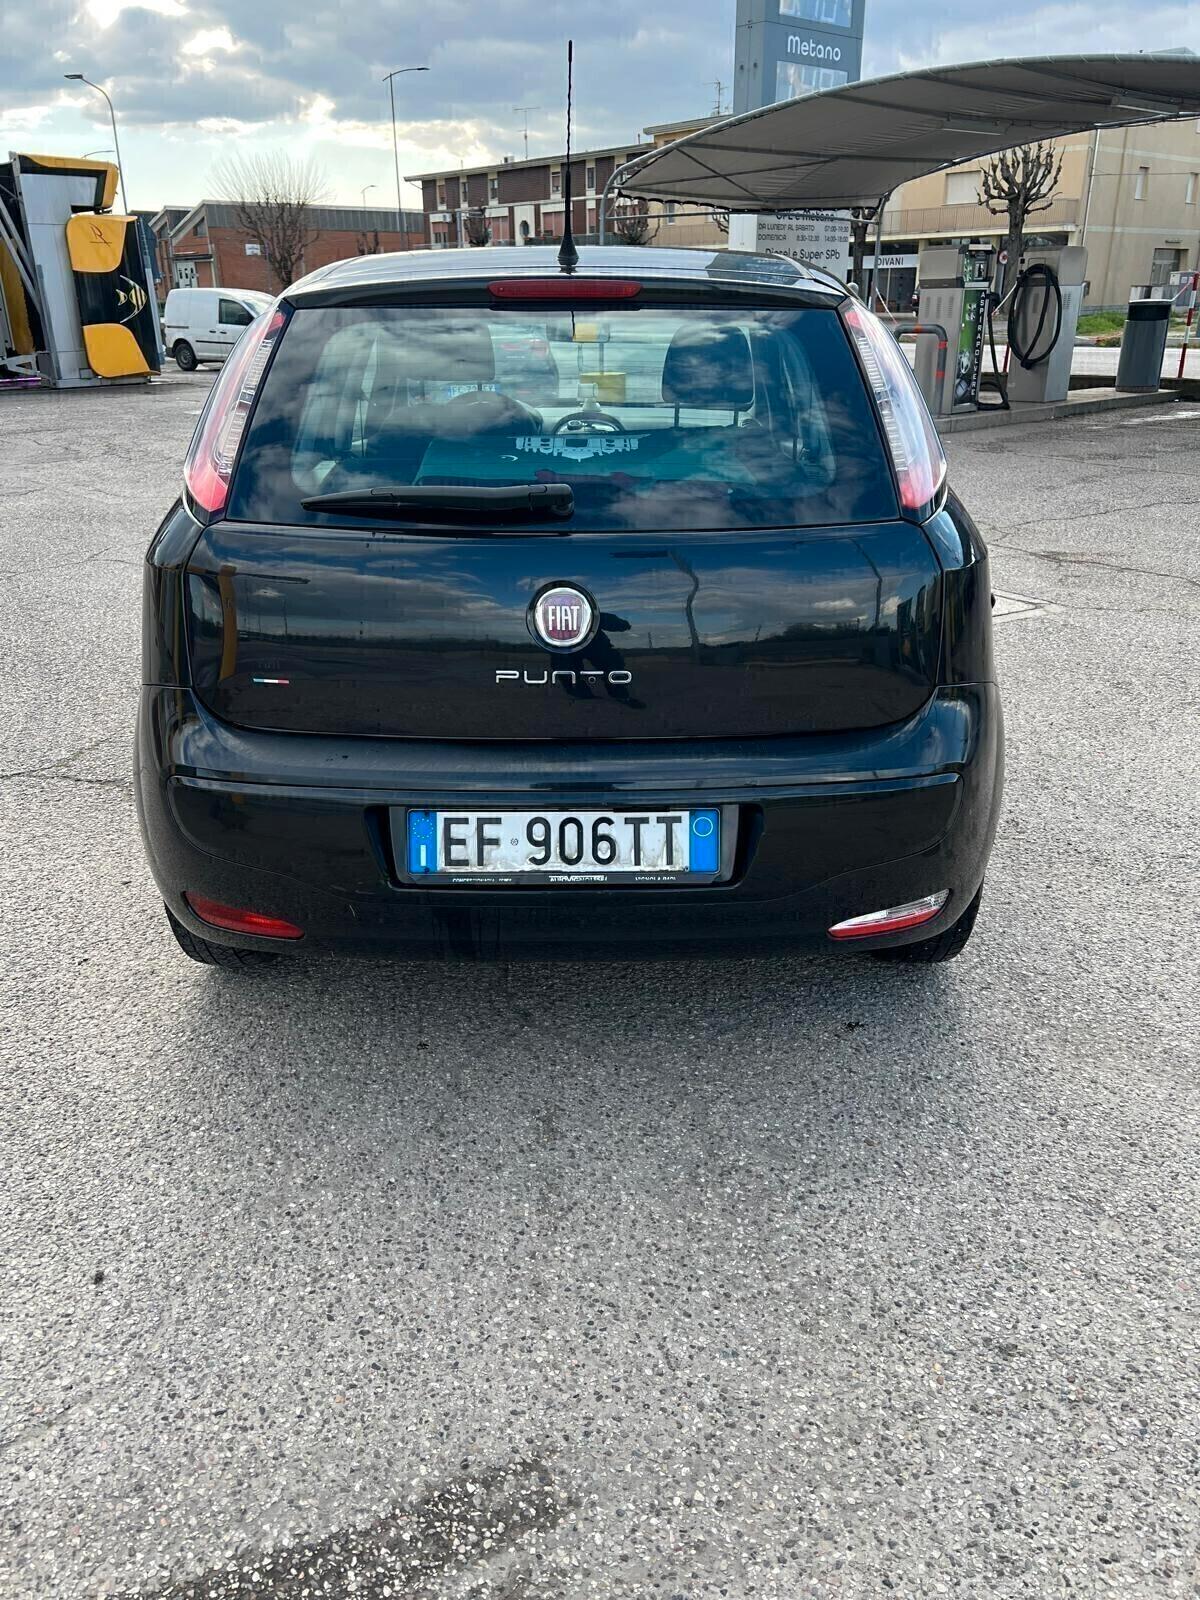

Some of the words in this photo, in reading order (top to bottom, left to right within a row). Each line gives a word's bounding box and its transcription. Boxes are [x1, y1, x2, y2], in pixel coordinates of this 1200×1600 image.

[787, 35, 841, 61] Metano
[795, 224, 815, 232] SABATO
[800, 249, 824, 262] Super
[877, 256, 904, 266] DIVANI
[548, 605, 580, 631] FIAT
[495, 670, 632, 684] PUNTO
[443, 817, 503, 867] EF
[525, 816, 683, 867] 906TT
